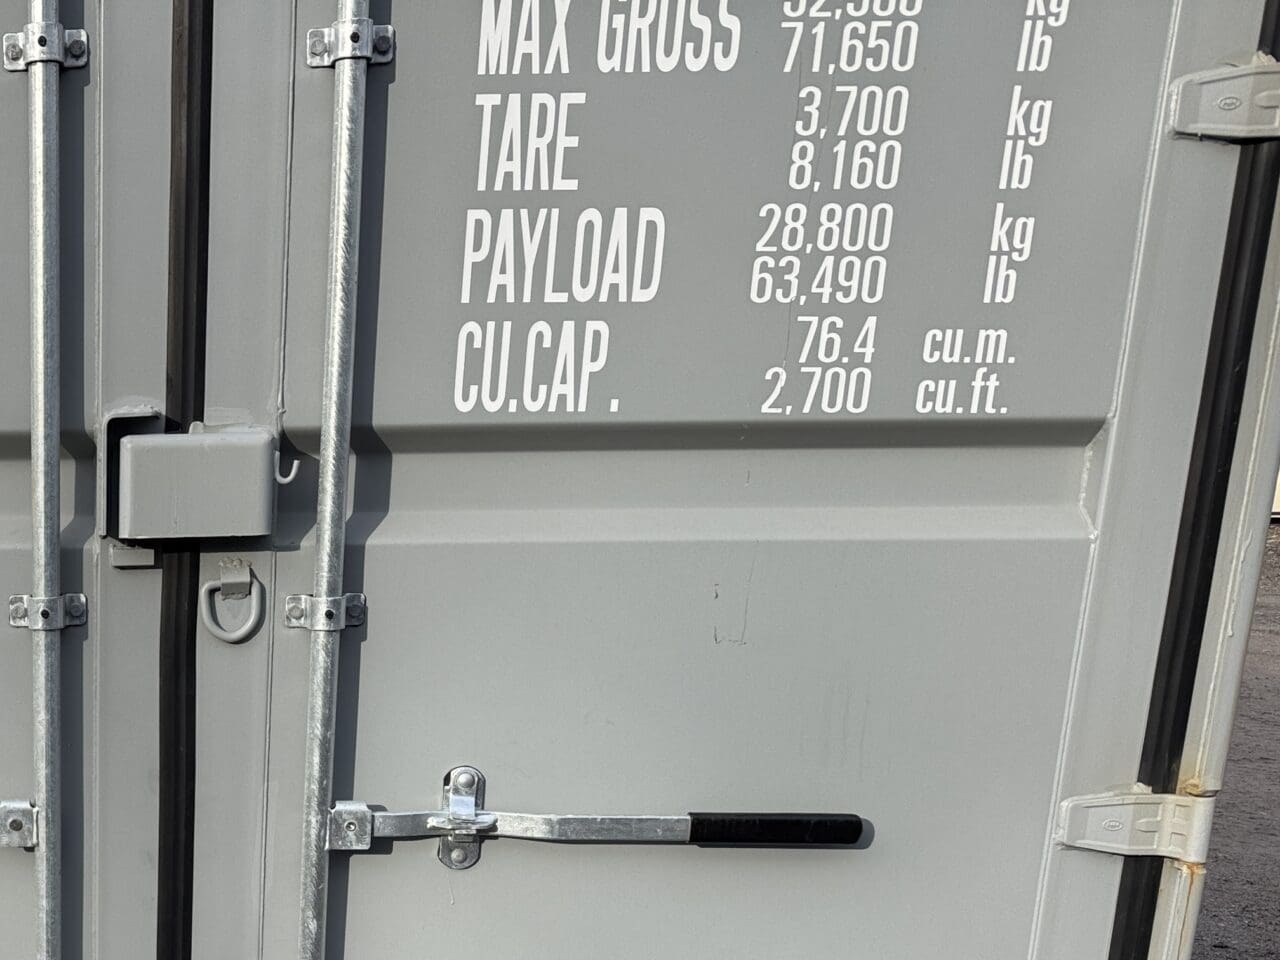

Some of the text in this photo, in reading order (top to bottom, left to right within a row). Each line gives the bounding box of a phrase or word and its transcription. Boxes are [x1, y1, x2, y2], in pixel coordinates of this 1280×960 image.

[477, 0, 741, 75] MAX GROSS
[781, 19, 1053, 75] 71,650 lb
[475, 92, 587, 192] TARE
[795, 85, 1053, 146] 3,700 kg
[788, 139, 1034, 192] 8,160 lb
[460, 207, 666, 304] PAYLOAD
[755, 202, 1035, 262] 28,800 kg
[749, 254, 1017, 306] 63,490 lb
[797, 315, 1016, 364] 76.4 cu.m.
[760, 366, 1008, 416] 2,700 cu.ft.
